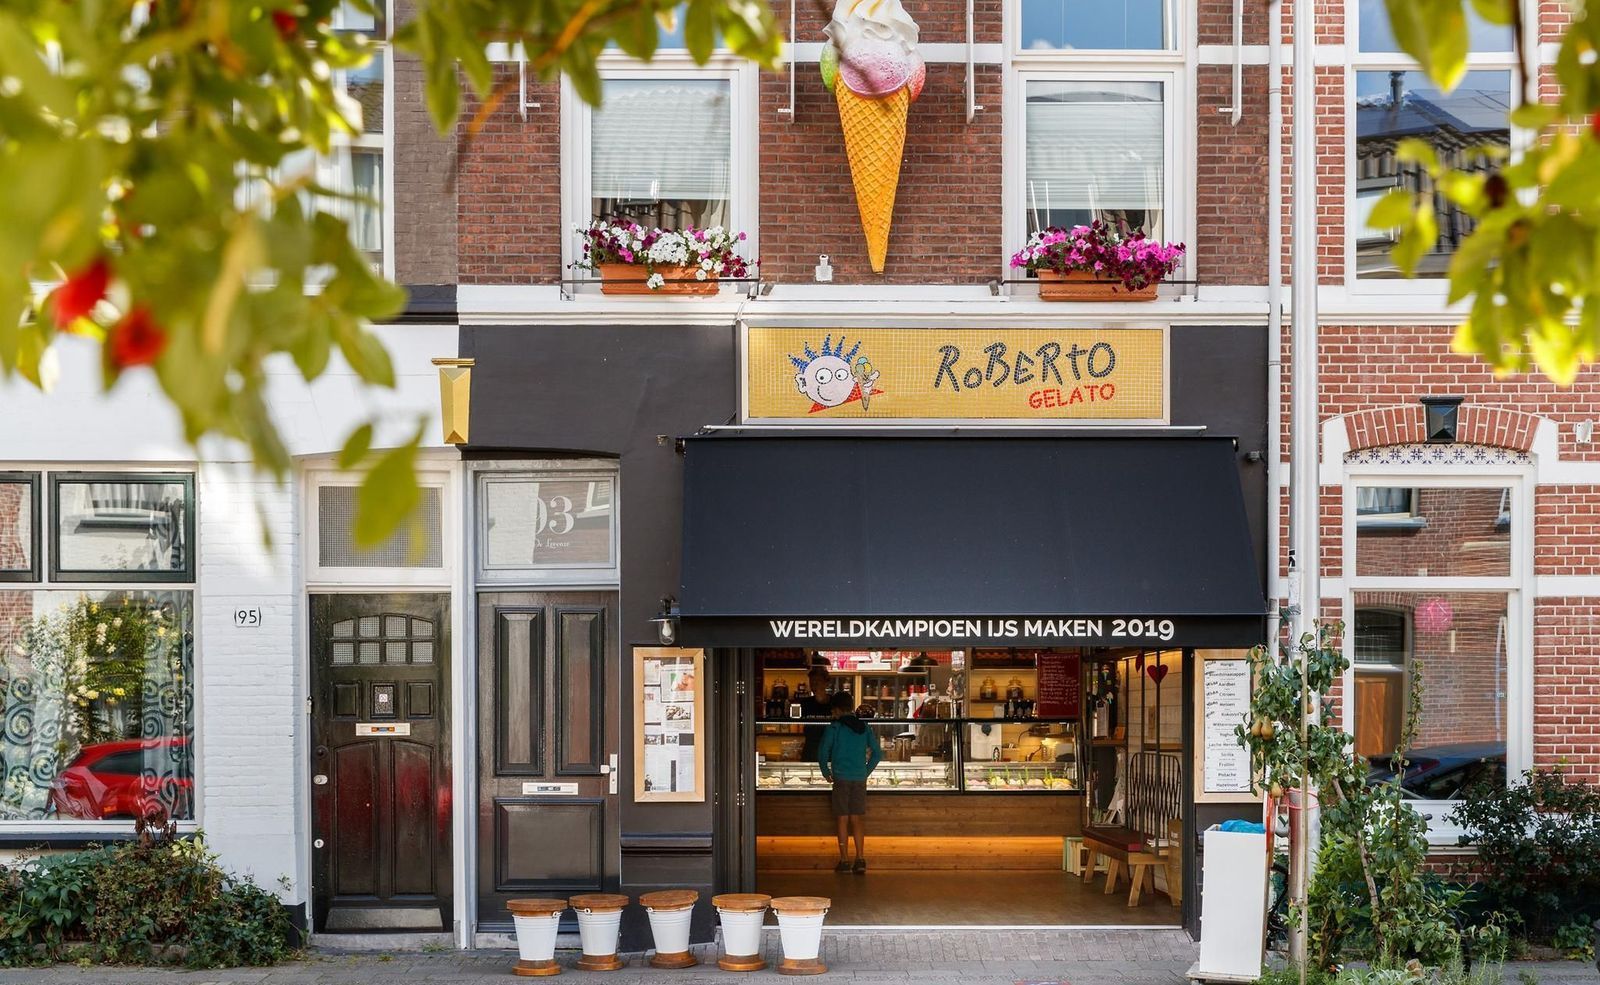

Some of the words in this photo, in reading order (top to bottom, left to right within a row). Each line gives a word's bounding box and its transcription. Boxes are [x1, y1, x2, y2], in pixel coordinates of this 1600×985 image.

[1028, 383, 1115, 409] GELATO
[769, 620, 981, 638] WERELDKAMPIOEN
[987, 620, 1018, 637] IJS
[1024, 620, 1103, 637] MAKEN
[1111, 619, 1175, 641] 2019
